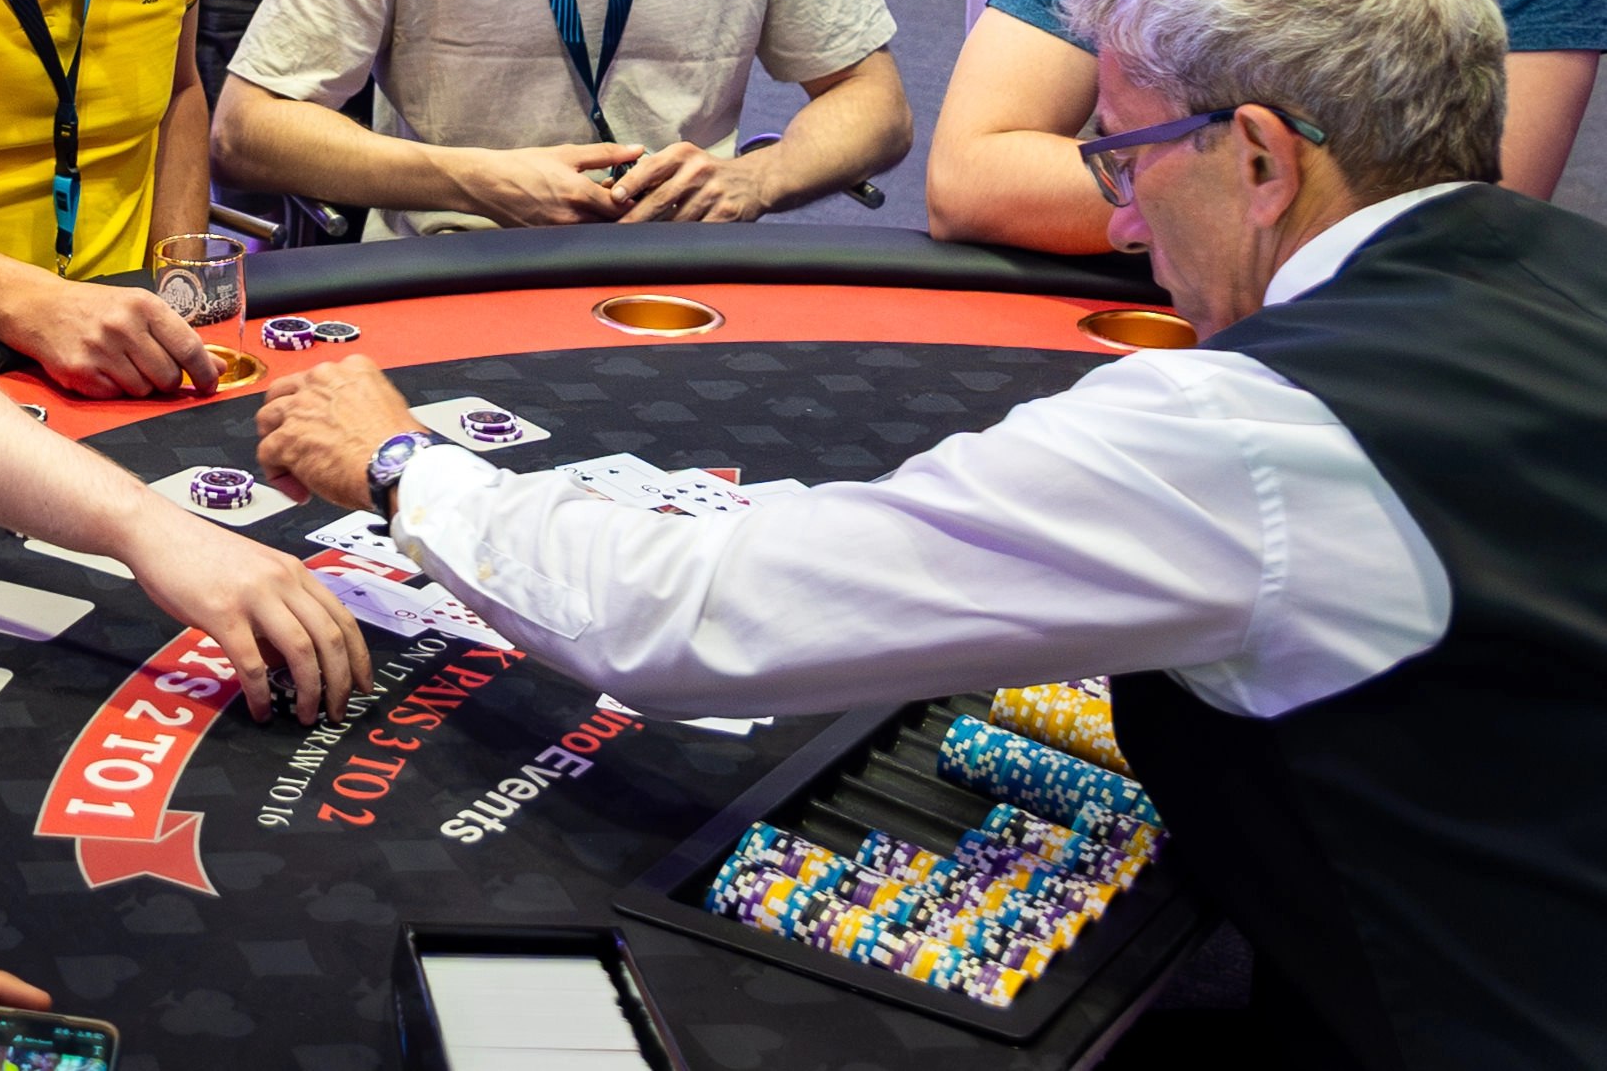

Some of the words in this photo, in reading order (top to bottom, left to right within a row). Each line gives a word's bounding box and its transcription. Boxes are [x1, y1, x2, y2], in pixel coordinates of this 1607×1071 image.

[400, 637, 448, 664] ON
[378, 662, 414, 682] 17
[387, 664, 495, 731] PAYS
[123, 699, 195, 727] 2
[368, 728, 422, 752] 3
[83, 733, 178, 791] TO
[269, 776, 311, 801] TO
[332, 754, 407, 800] TO
[439, 707, 645, 844] inoEvents
[64, 797, 136, 818] 1
[257, 805, 295, 828] 16
[316, 802, 377, 826] 2
